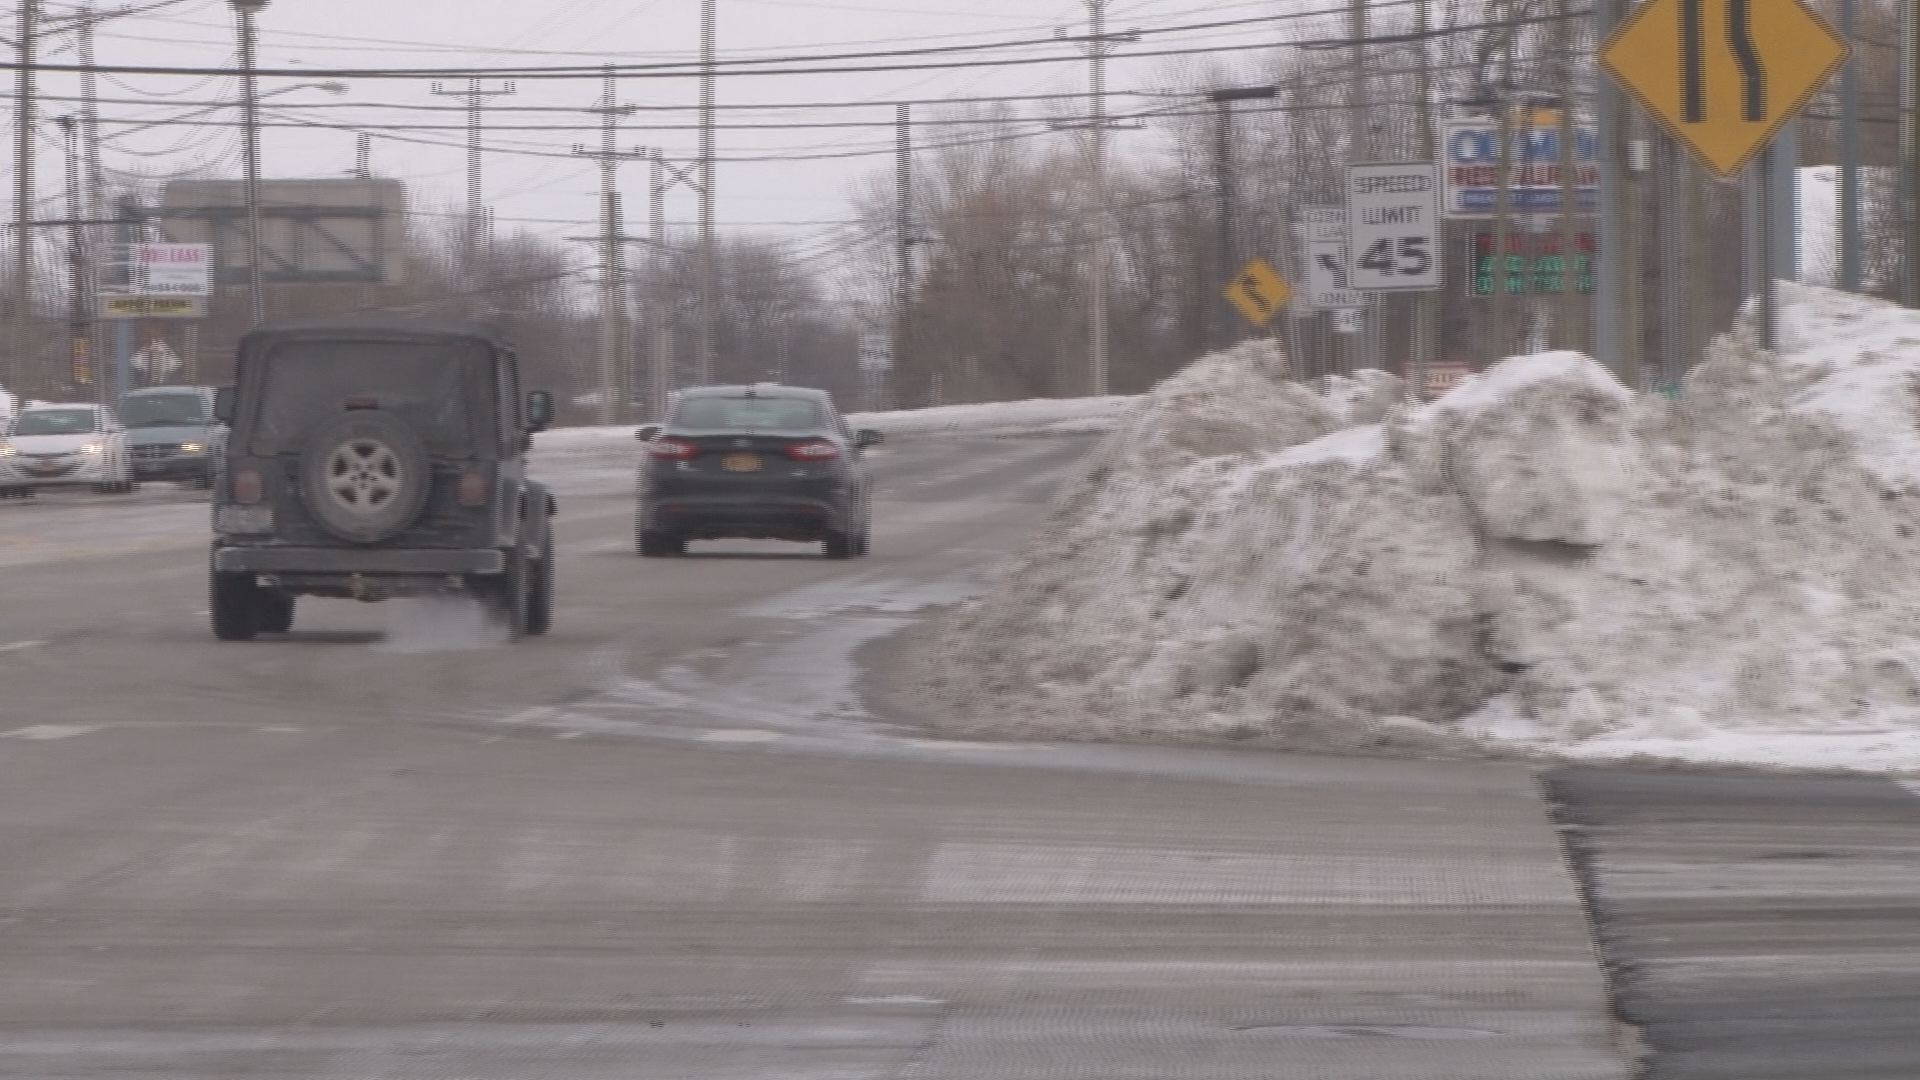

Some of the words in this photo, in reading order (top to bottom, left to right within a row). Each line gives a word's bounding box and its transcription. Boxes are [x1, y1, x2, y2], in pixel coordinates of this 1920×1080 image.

[1355, 175, 1432, 193] SPEED
[1449, 165, 1600, 188] RESAURAN
[1308, 210, 1346, 223] CEN
[1363, 205, 1423, 224] LIMIT
[1318, 226, 1346, 238] LA
[1356, 236, 1433, 277] 45
